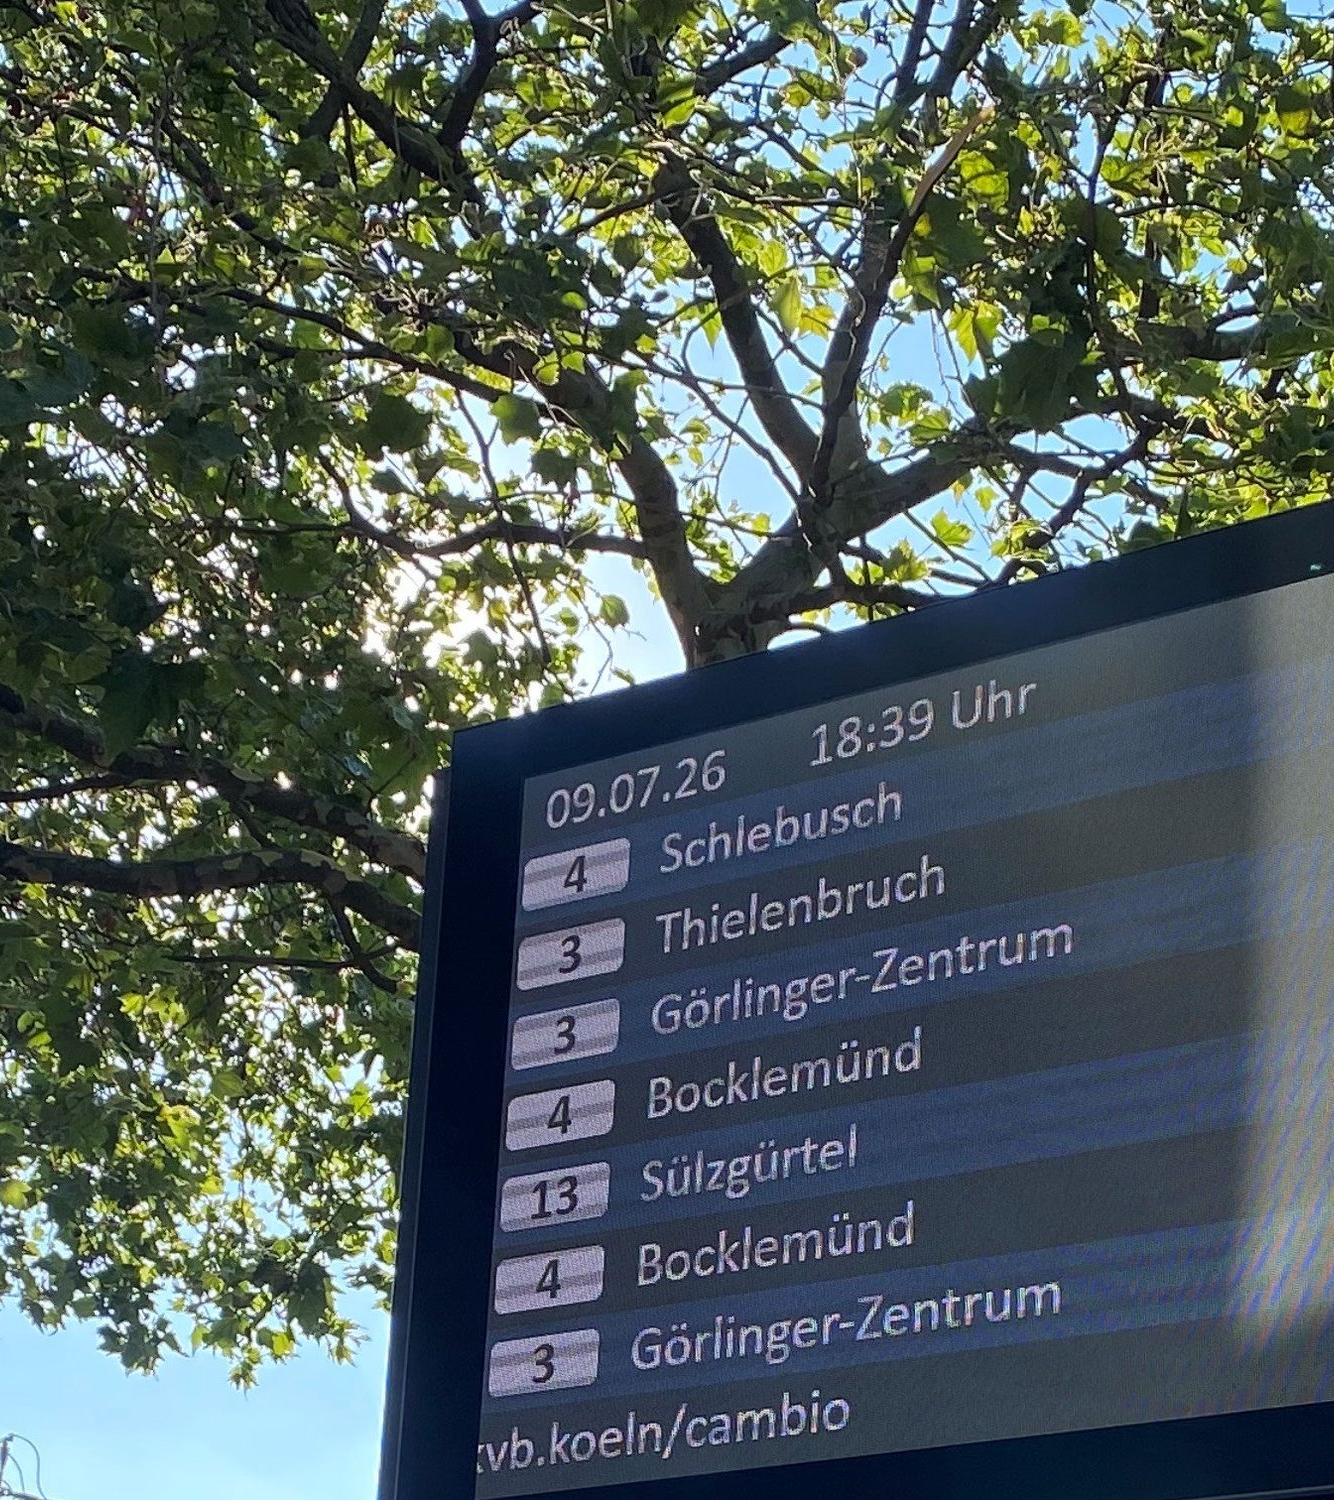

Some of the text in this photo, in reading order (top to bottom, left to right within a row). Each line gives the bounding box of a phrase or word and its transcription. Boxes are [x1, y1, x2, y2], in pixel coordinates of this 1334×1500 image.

[546, 677, 1038, 830] 09.07.26 18:39 Uhr
[564, 858, 586, 893] 4
[660, 781, 903, 874] Schlebusch
[559, 937, 581, 974] 3
[657, 856, 946, 955] Thielenbruch
[554, 1018, 577, 1055] 3
[651, 922, 1074, 1037] Görlinger-Zentrum
[547, 1097, 571, 1136] 4
[647, 1026, 924, 1120] Bocklemünd
[532, 1176, 579, 1219] 13
[640, 1124, 859, 1204] Sülzgürtel
[536, 1261, 561, 1299] 4
[636, 1202, 915, 1288] Bocklemünd
[532, 1344, 556, 1385] 3
[630, 1274, 1063, 1372] Görlinger-Zentrum
